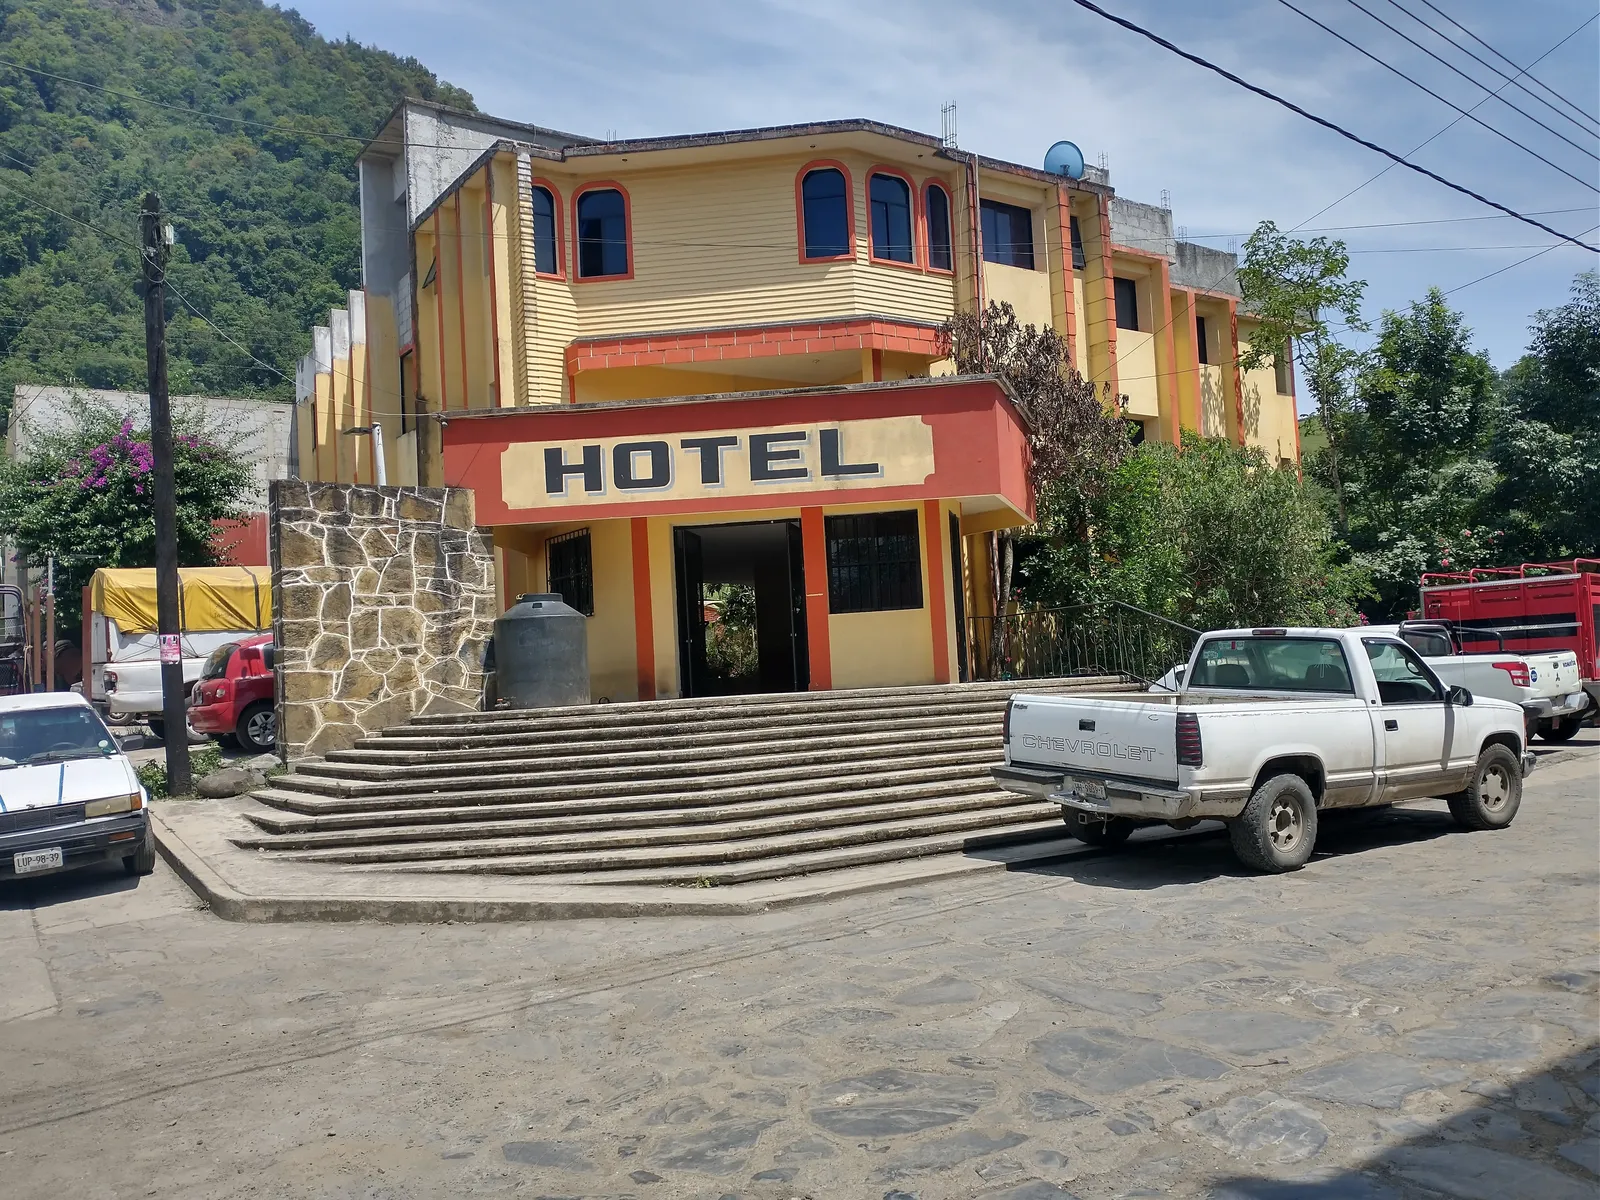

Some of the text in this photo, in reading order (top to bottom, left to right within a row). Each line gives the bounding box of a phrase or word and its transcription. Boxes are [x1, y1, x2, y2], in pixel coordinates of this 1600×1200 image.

[544, 428, 882, 496] HOTEL
[1022, 733, 1157, 762] CHEVROLET
[16, 852, 60, 868] LUP-98-39
